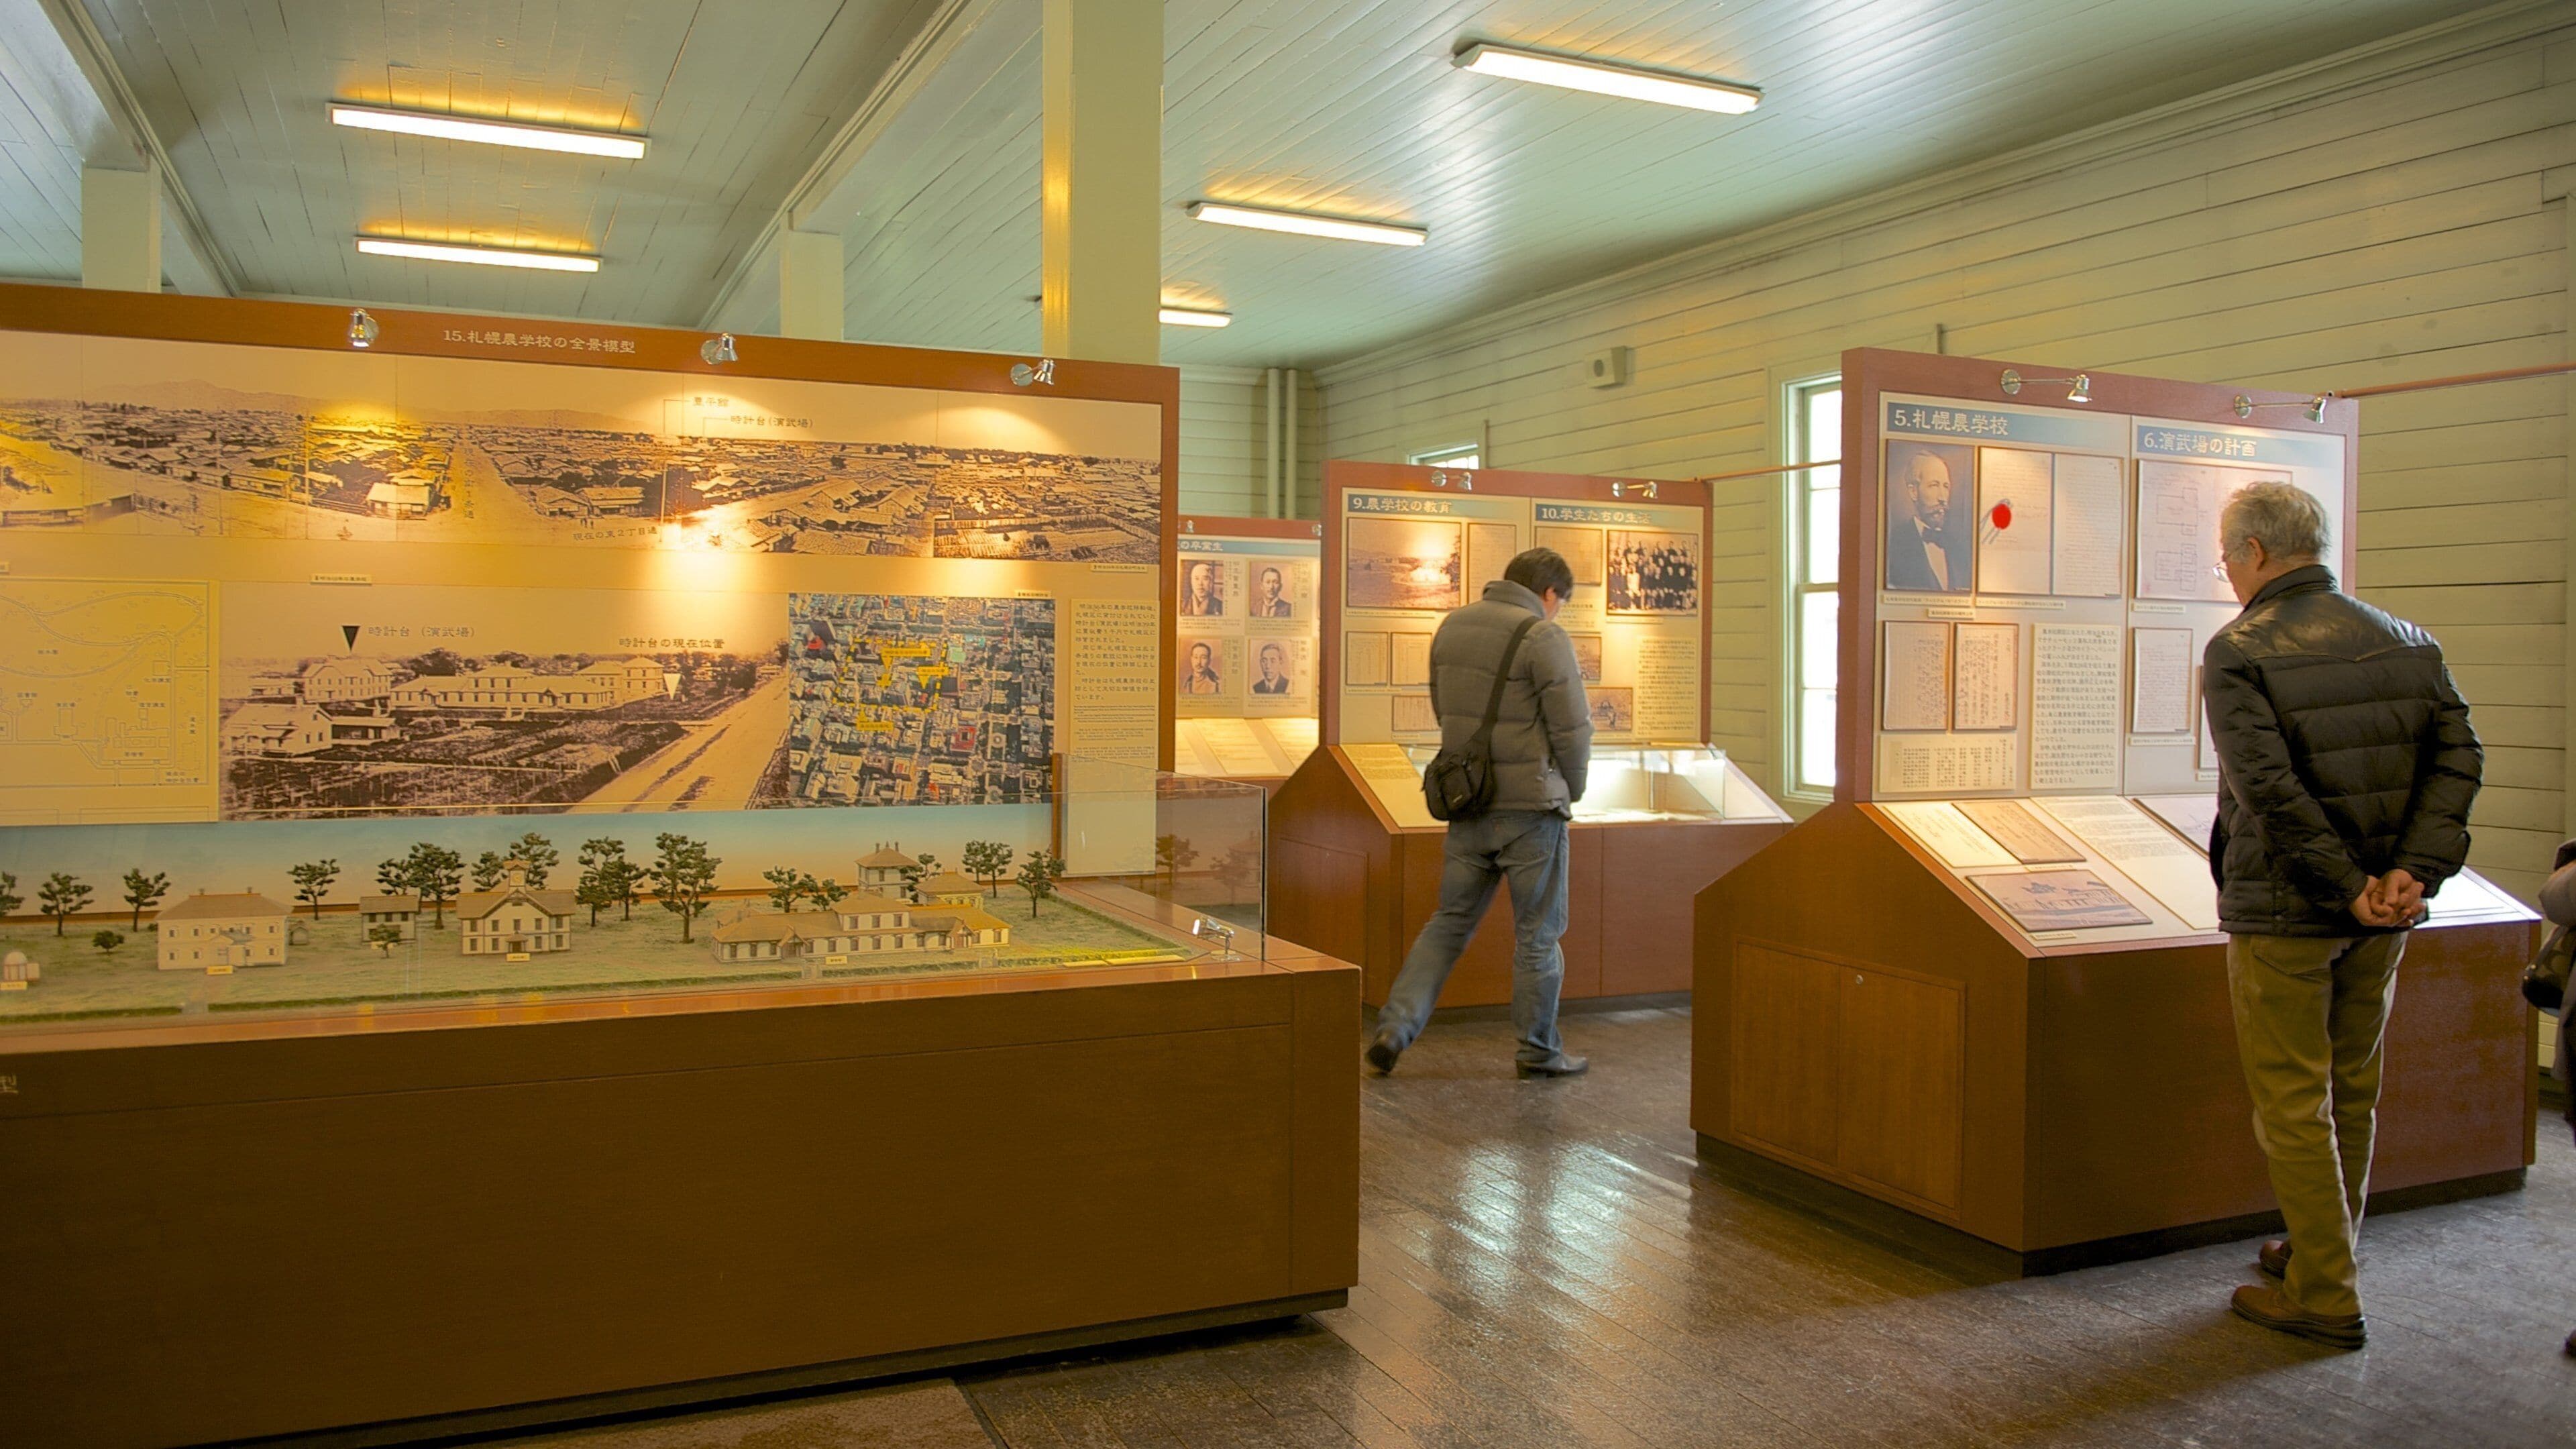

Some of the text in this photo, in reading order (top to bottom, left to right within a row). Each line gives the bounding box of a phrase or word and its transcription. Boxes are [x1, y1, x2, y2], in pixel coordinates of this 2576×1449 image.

[443, 329, 636, 354] 15.札幌農学校の全景模型
[1894, 409, 2008, 435] 5.札幌農学校
[2144, 431, 2258, 457] 6.演武場の計画
[1352, 497, 1452, 514] 9.農学校の教育
[1542, 507, 1652, 524] 10.学生たちの生活
[1177, 541, 1224, 552] の卒業生
[619, 637, 725, 649] 時計台の現在位置
